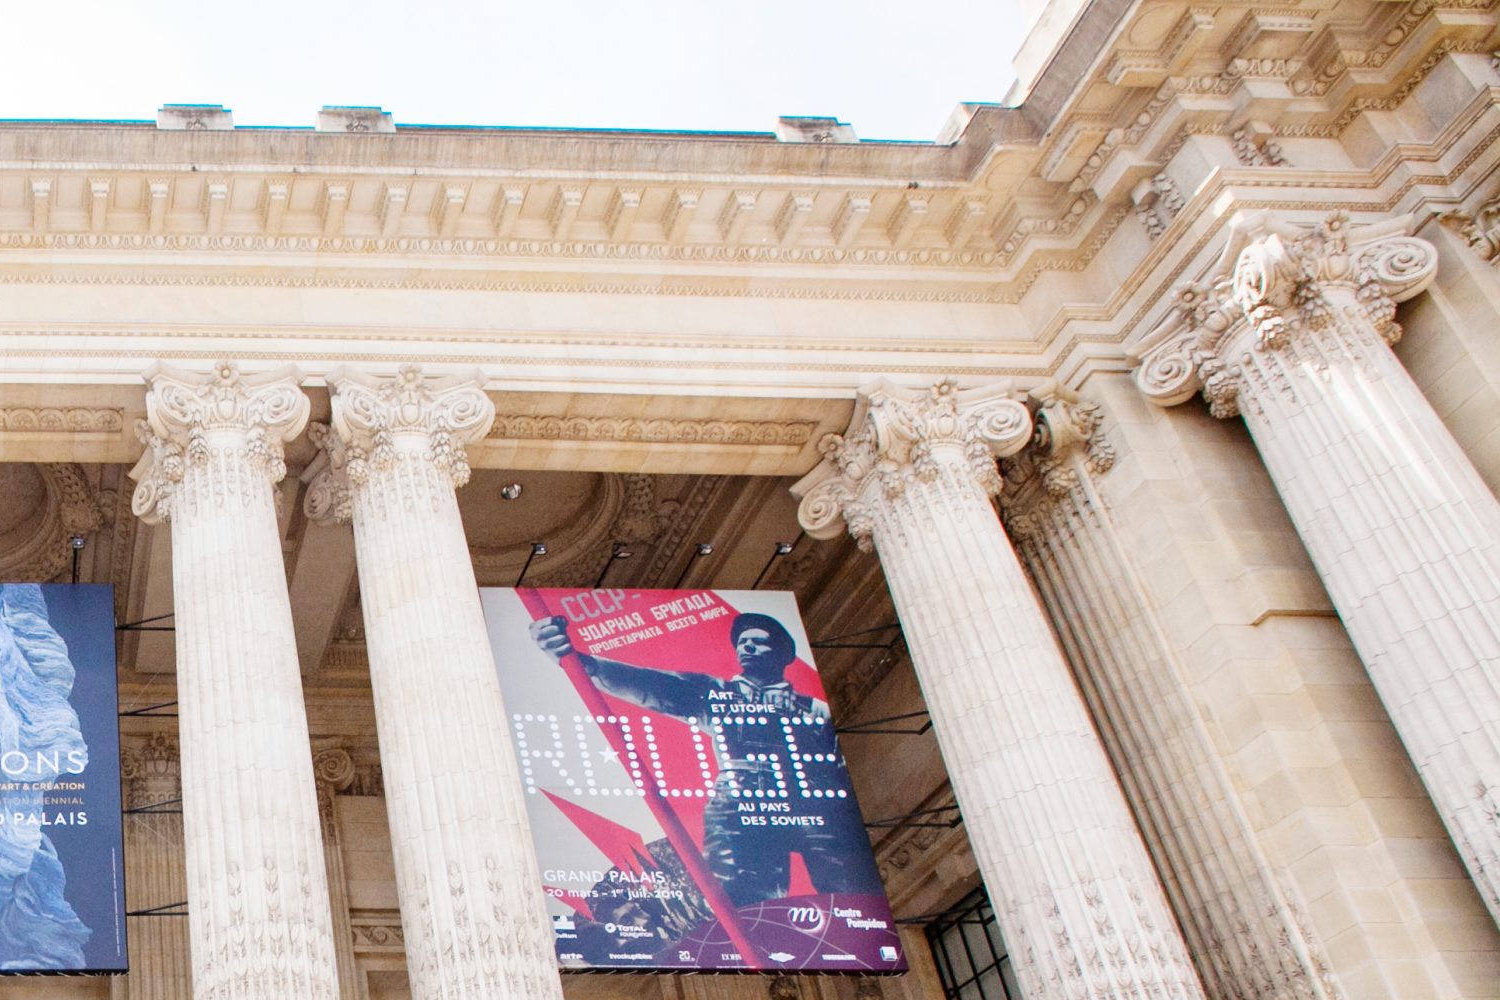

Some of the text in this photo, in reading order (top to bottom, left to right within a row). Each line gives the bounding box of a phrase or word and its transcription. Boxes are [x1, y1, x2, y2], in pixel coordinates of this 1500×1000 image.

[577, 592, 716, 641] УДАРНАЯ БРИГАДА
[665, 616, 698, 632] ВСЕГО
[700, 606, 729, 622] МИРА
[711, 704, 776, 713] ET UTOPIE
[513, 714, 847, 798] ROUGE
[32, 781, 85, 791] CRÉATION
[738, 803, 791, 812] AU PAYS
[14, 811, 88, 826] PALAIS
[741, 816, 825, 826] DES SOVIETS
[544, 869, 665, 883] GRAND PALAIS
[547, 888, 564, 898] 20
[568, 889, 599, 898] mars
[627, 886, 650, 900] juil.
[654, 889, 684, 900] 2019
[834, 907, 862, 917] Centre
[846, 918, 887, 930] Pompidou
